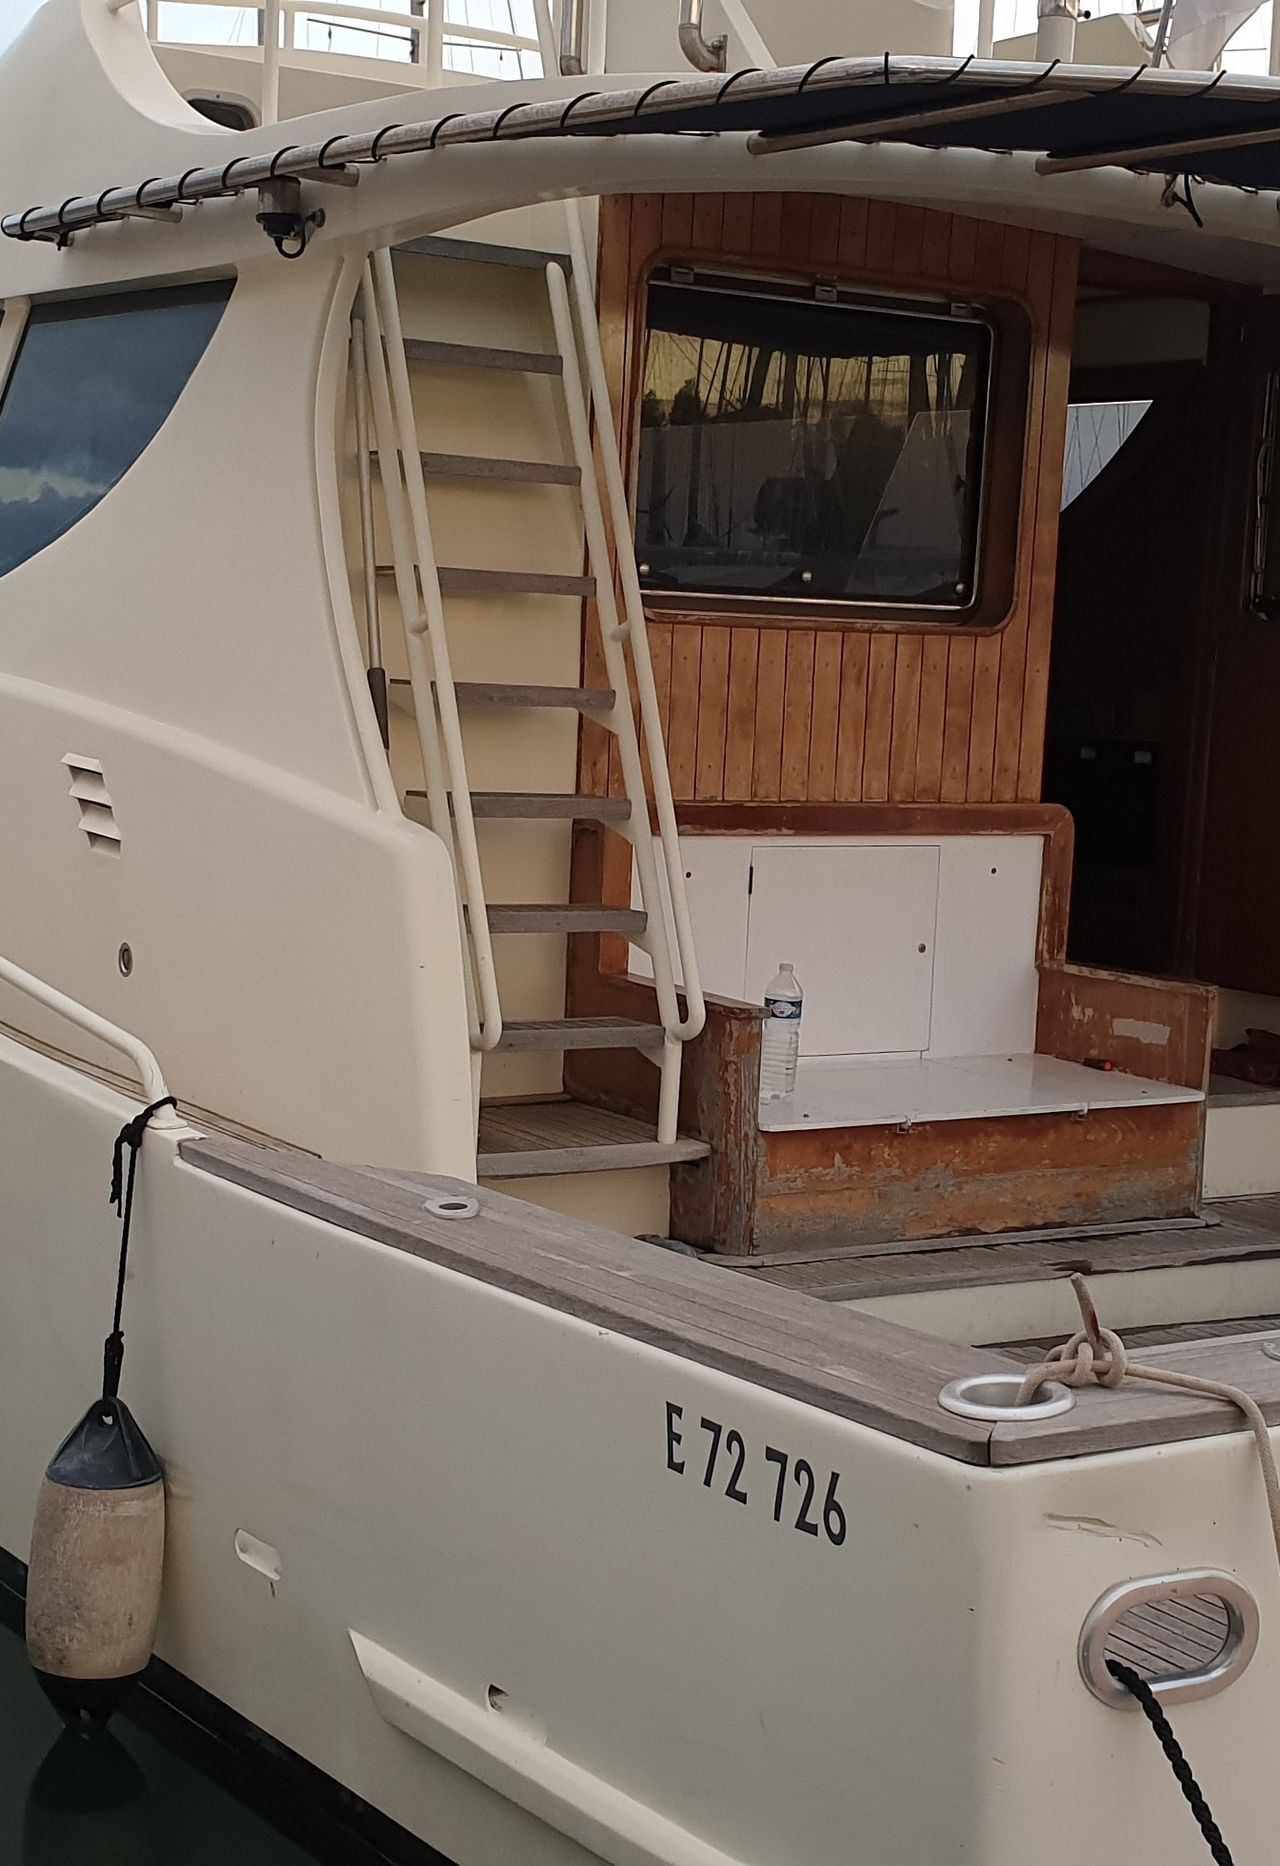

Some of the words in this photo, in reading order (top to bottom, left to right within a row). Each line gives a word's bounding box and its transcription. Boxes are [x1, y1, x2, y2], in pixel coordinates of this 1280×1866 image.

[665, 1400, 685, 1475] E
[700, 1416, 748, 1505] 72
[765, 1445, 847, 1546] 726
